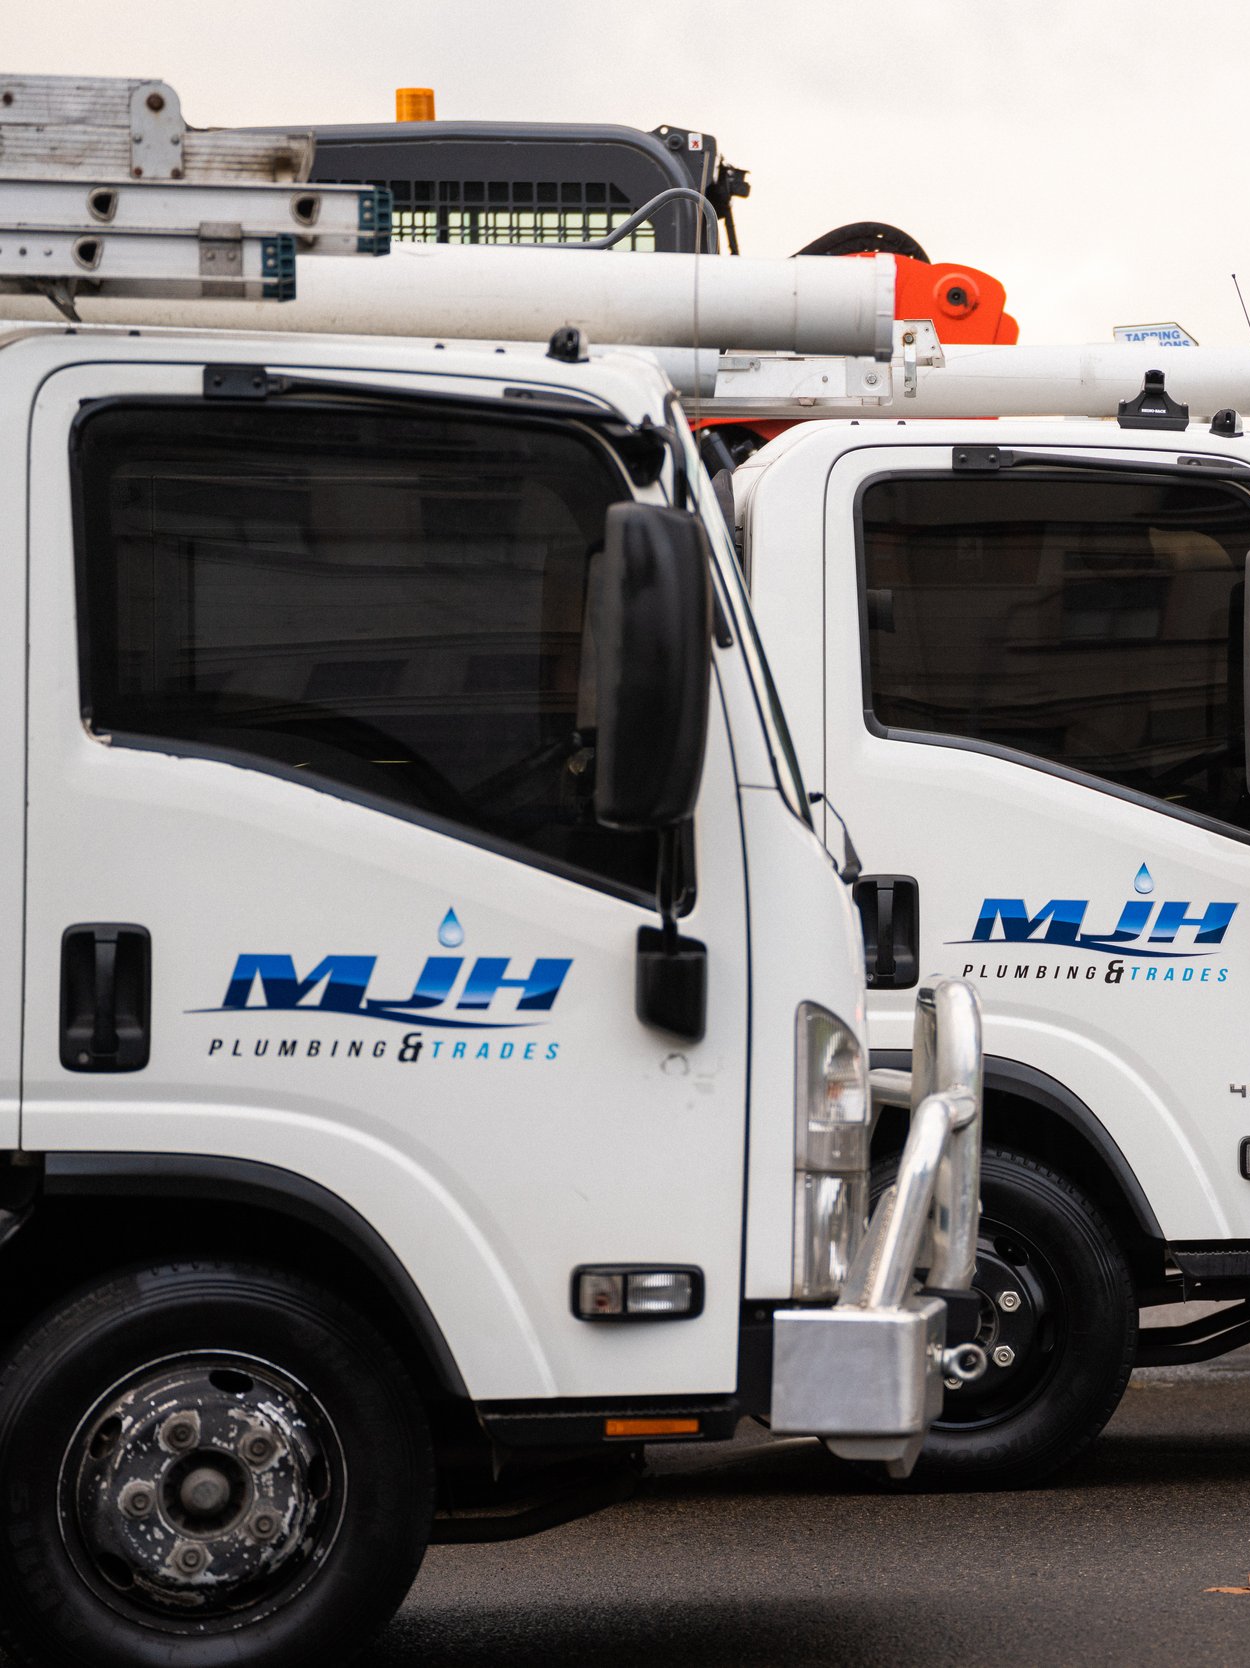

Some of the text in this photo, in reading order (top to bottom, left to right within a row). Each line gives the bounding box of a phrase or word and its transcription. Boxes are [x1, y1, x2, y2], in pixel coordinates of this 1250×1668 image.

[971, 898, 1239, 944] MJH
[221, 953, 574, 1011] MJH
[962, 960, 1228, 983] PLUMBING & TRADES
[208, 1033, 559, 1063] PLUMBING & TRADES
